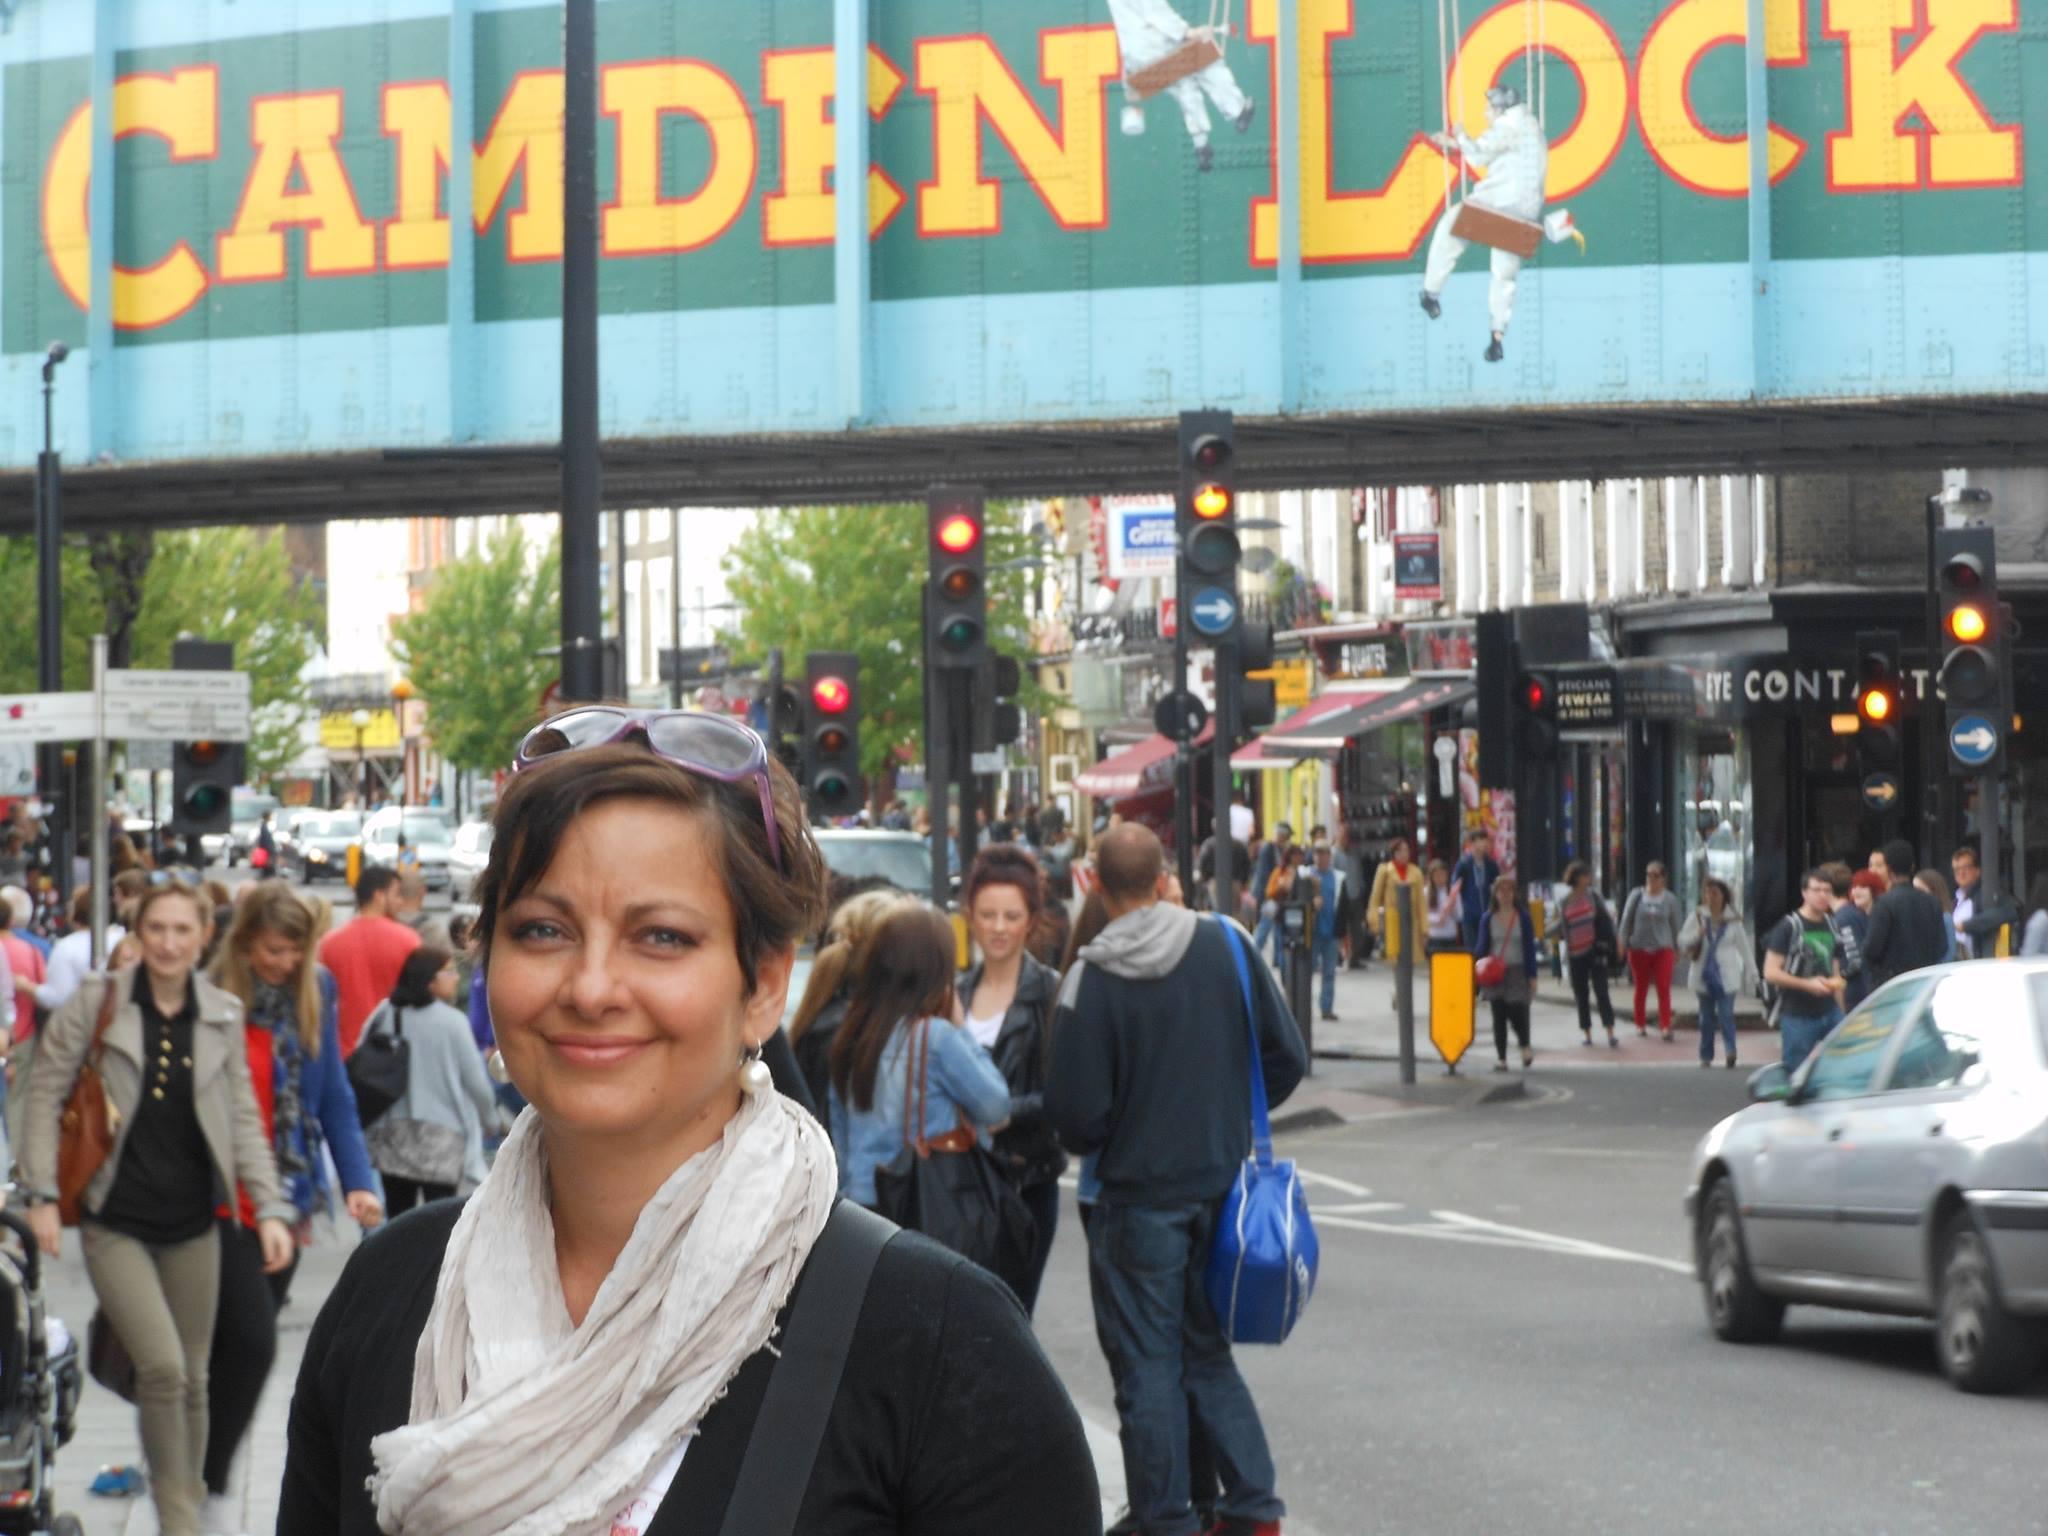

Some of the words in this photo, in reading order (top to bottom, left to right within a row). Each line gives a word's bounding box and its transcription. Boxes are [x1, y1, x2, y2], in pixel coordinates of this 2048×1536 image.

[42, 24, 1122, 331] CAMDEN
[1245, 0, 2023, 268] LOCK
[1706, 671, 1732, 701] EYE
